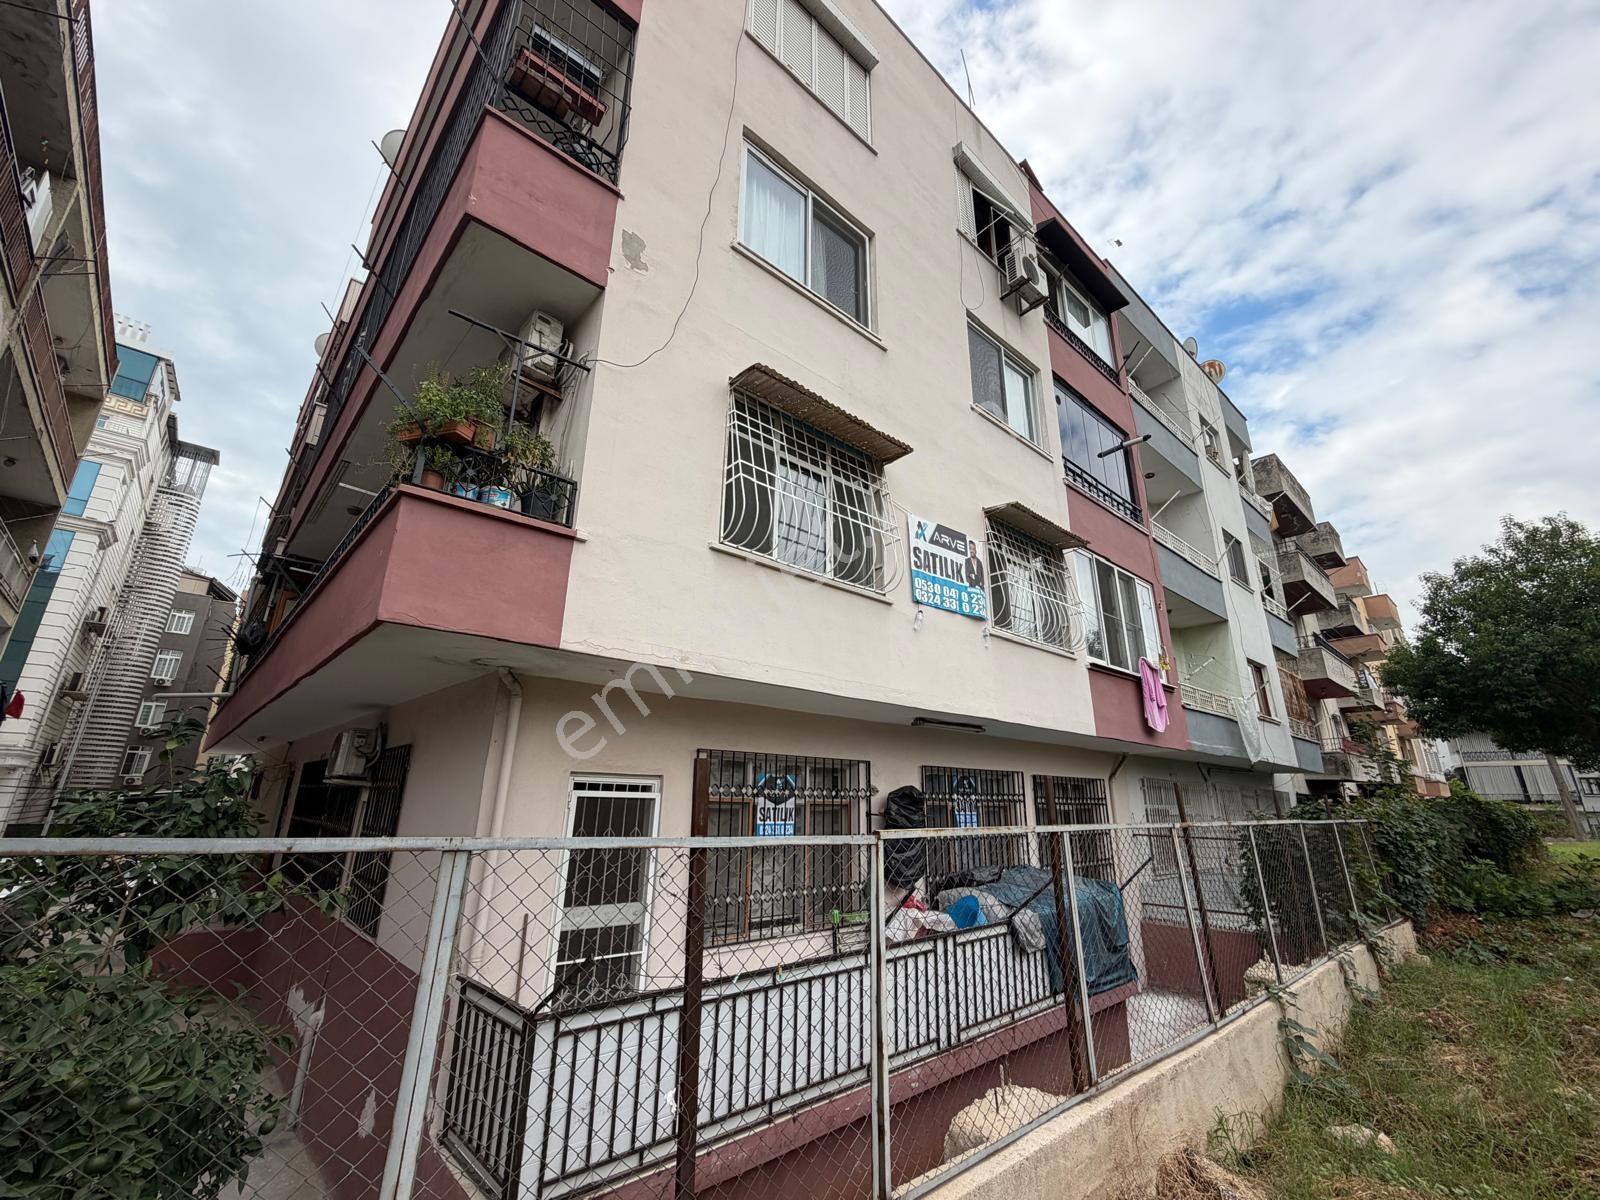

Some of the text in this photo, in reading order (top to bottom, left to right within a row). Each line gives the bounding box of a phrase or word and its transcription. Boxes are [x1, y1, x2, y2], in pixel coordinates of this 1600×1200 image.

[933, 531, 966, 552] ARVE
[912, 546, 965, 585] SATILIK
[914, 577, 941, 595] 0530
[915, 588, 941, 606] 0324
[759, 807, 794, 822] SATILIK
